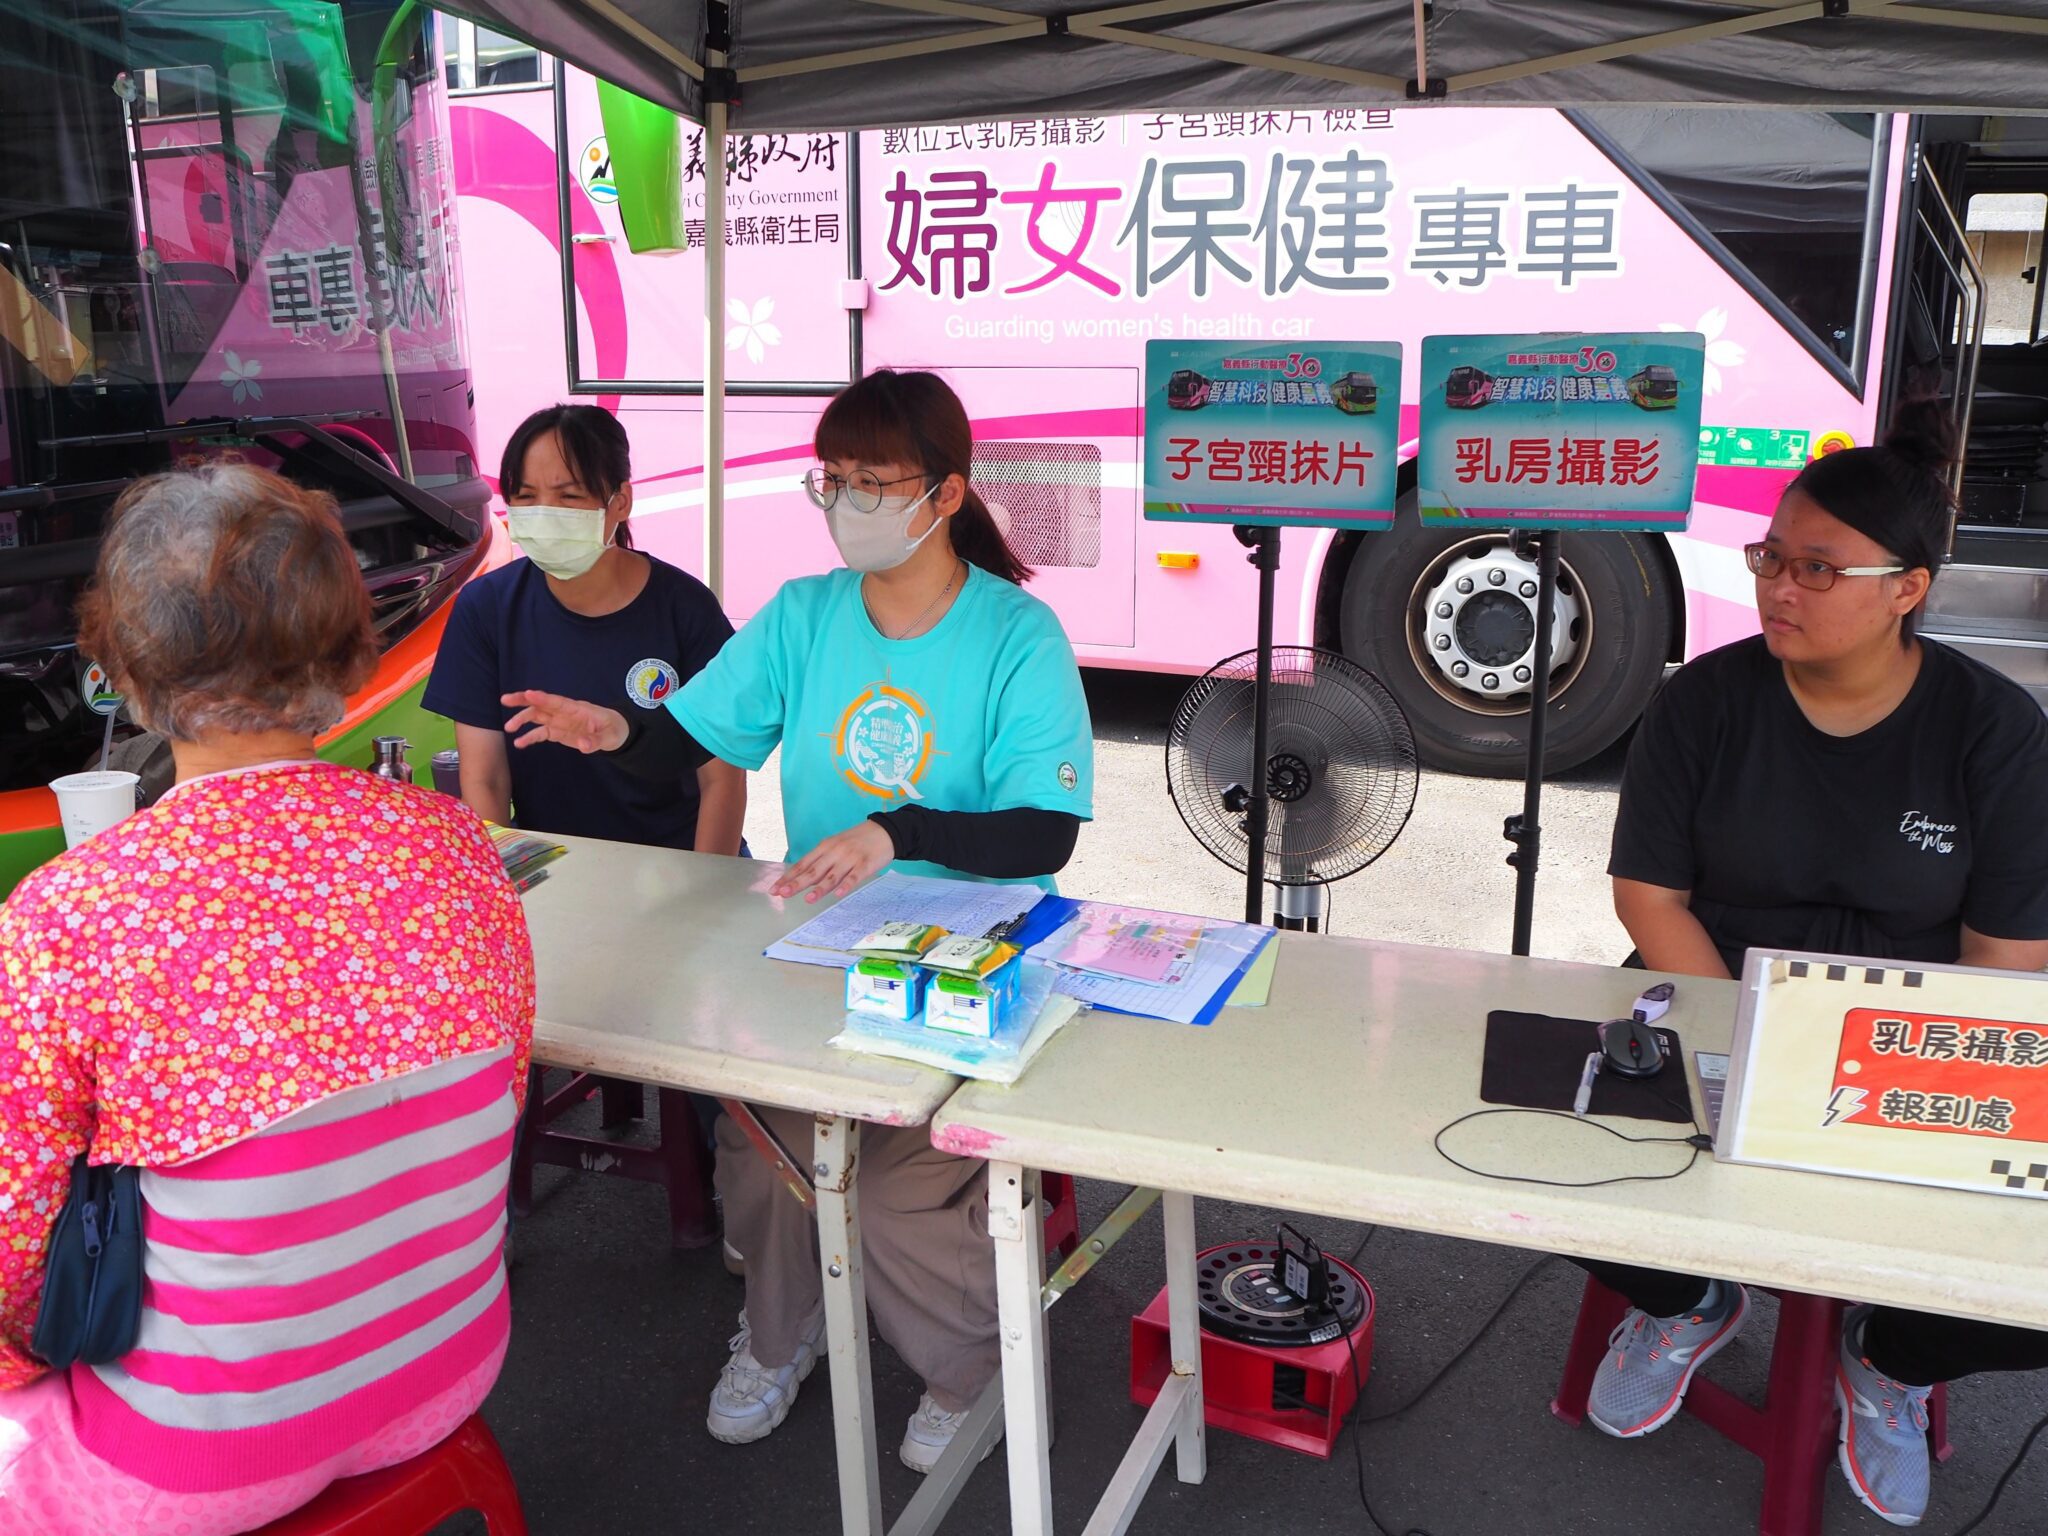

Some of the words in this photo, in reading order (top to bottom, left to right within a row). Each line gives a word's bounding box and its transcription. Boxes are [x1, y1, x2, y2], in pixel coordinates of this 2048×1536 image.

[695, 190, 745, 209] Cnty
[749, 188, 838, 206] Government
[945, 314, 1054, 344] Guarding
[1062, 314, 1173, 337] women's
[1182, 312, 1262, 337] health
[1271, 317, 1314, 337] car
[1208, 380, 1268, 404] 智慧科技
[1491, 377, 1556, 401] 智慧科技
[1726, 428, 1737, 438] 2
[1770, 430, 1781, 440] 3
[1165, 438, 1374, 487] 子宮頸抹片
[1455, 437, 1660, 486] 乳房攝影
[1899, 810, 1958, 833] Embrace
[1904, 831, 1923, 842] the
[1872, 1020, 2048, 1066] 乳房攝影
[1880, 1089, 2014, 1133] 報到處
